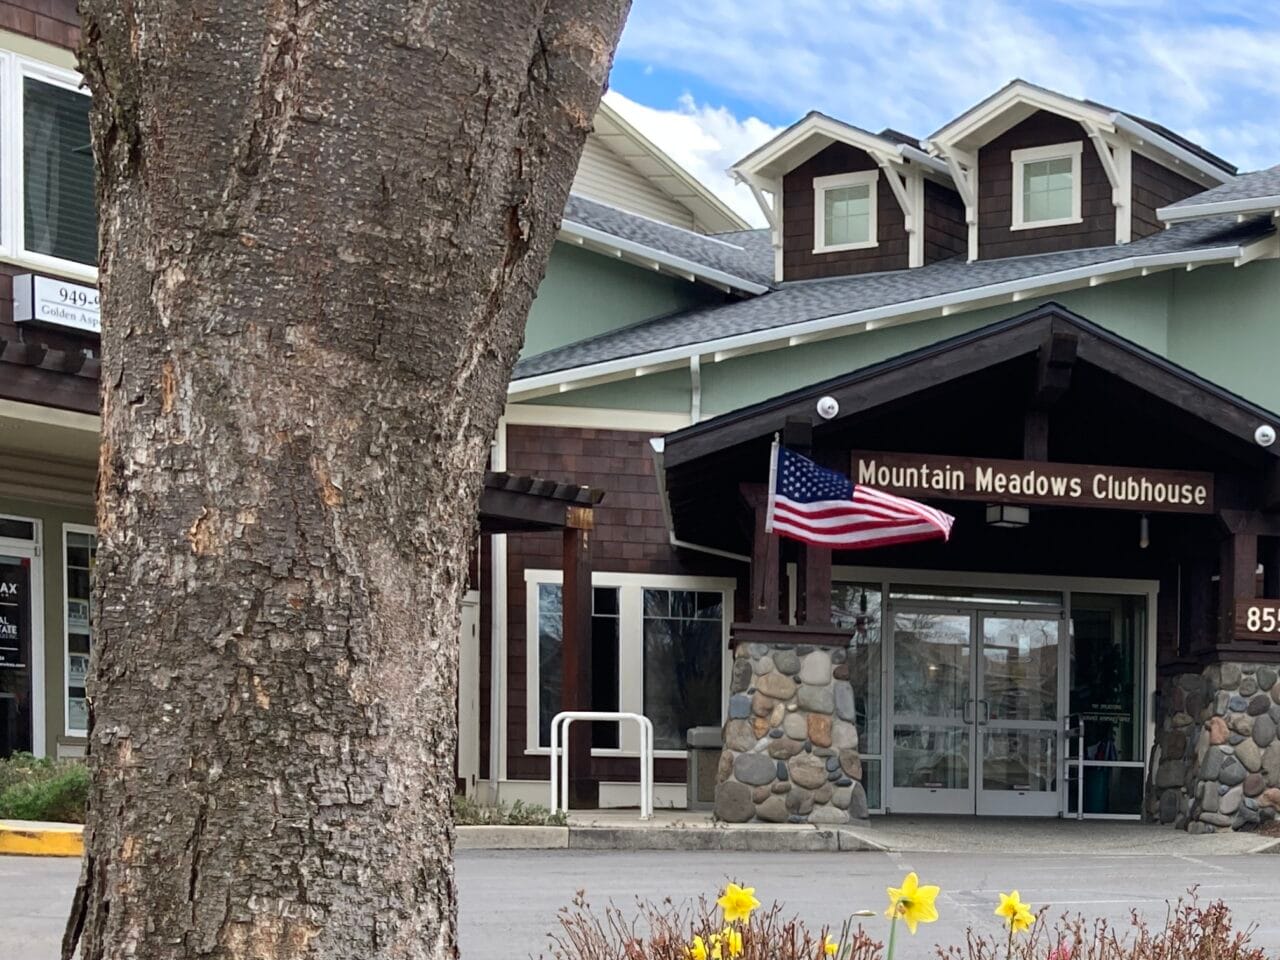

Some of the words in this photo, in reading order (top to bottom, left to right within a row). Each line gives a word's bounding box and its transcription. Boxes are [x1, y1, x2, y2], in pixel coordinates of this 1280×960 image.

[41, 305, 76, 320] Golden
[858, 459, 965, 491] Mountain
[975, 466, 1082, 497] Meadows
[1092, 473, 1207, 505] Clubhouse
